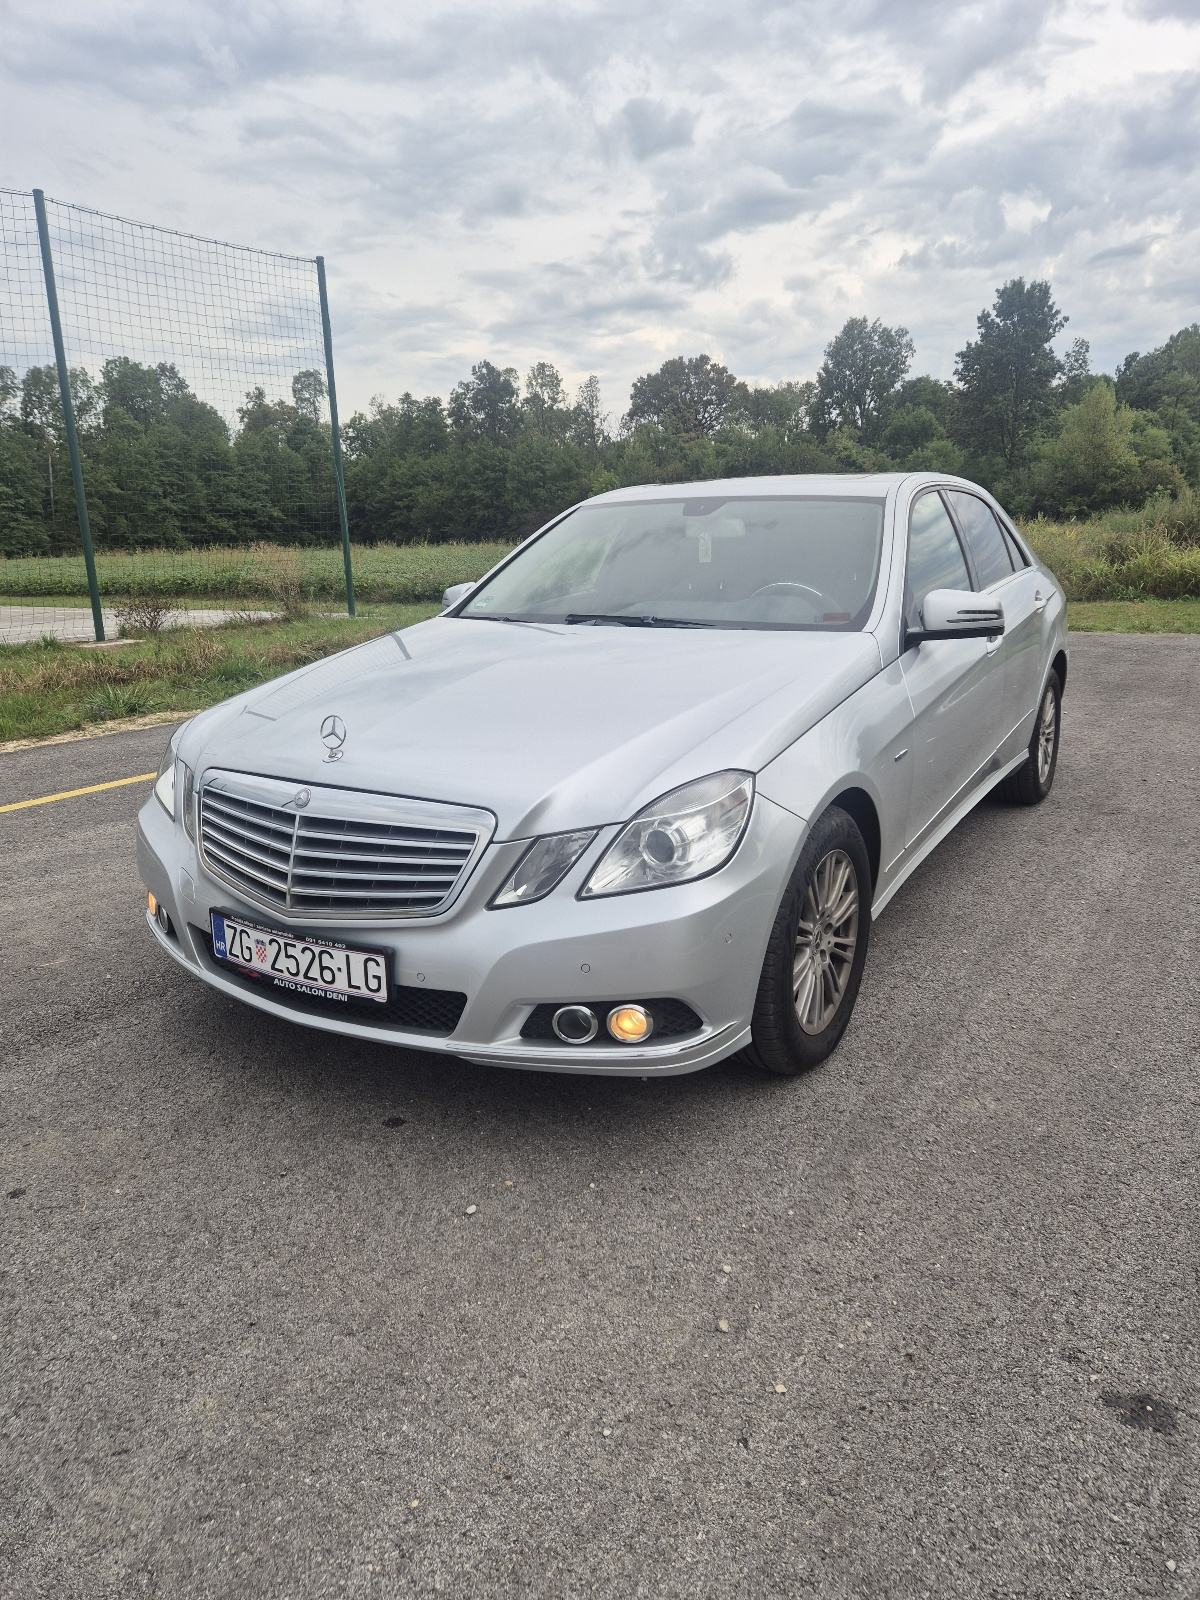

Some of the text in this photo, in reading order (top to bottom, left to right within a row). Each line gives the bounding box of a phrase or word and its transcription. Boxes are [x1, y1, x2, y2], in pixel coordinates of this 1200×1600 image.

[215, 939, 226, 952] HR
[226, 923, 253, 963] ZG
[273, 978, 348, 1002] AUTO SALON DENI
